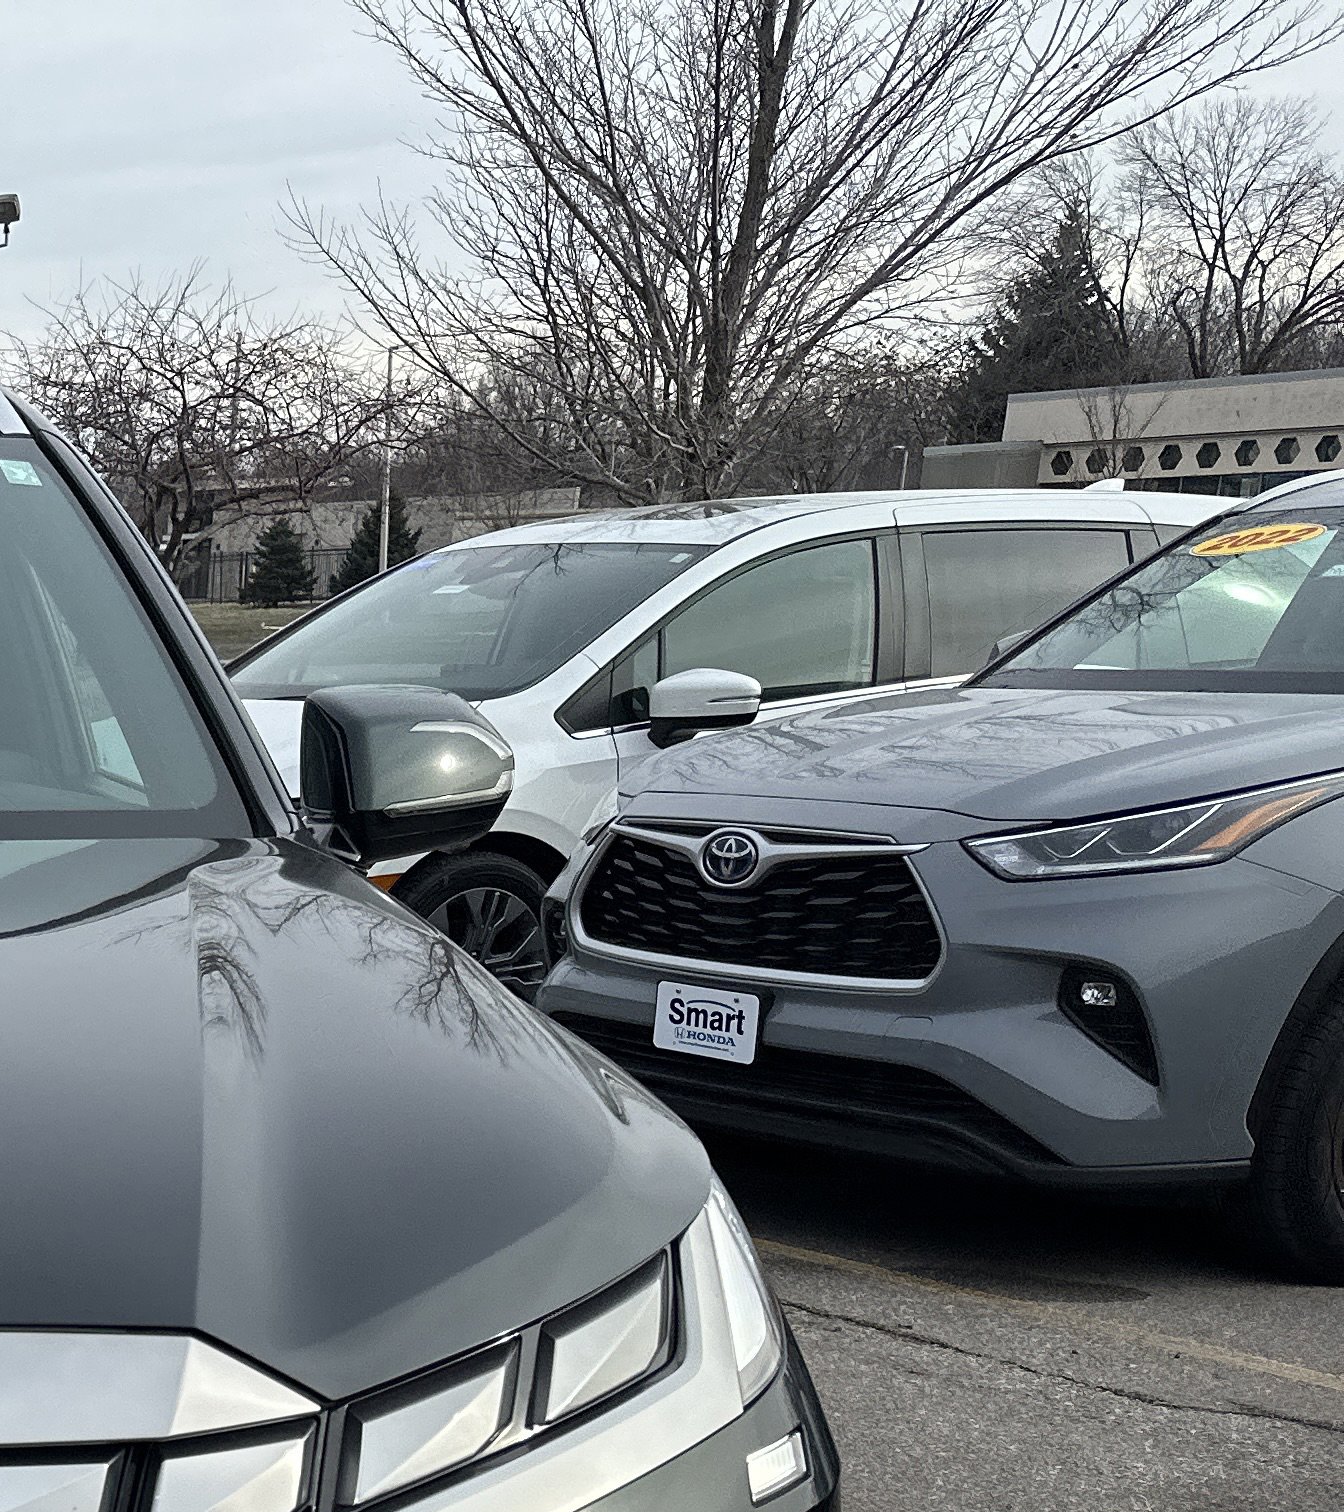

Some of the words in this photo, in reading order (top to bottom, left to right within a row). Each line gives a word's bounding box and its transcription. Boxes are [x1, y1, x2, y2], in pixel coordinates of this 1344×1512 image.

[1198, 527, 1319, 553] 2022
[669, 998, 745, 1035] Smart
[686, 1029, 736, 1047] HONDA
